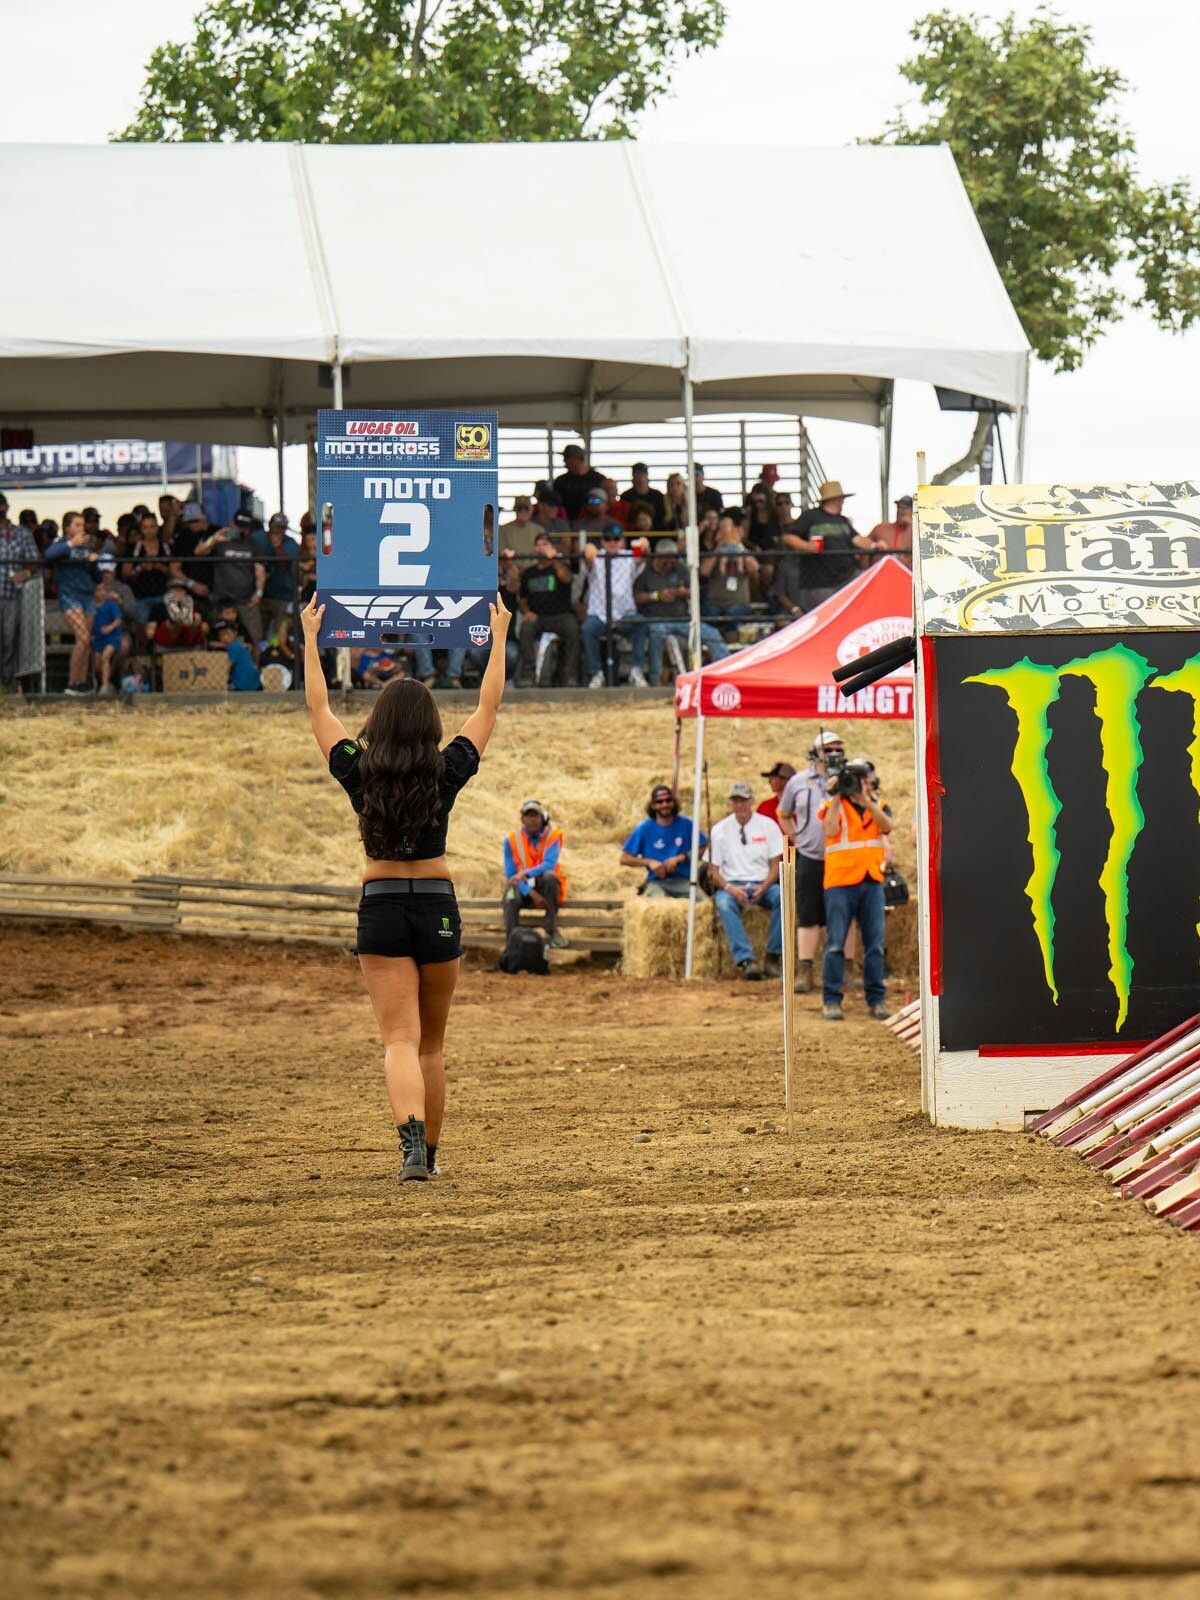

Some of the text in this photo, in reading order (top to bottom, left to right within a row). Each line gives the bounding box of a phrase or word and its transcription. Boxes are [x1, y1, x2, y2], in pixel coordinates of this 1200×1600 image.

[350, 422, 417, 435] LUCAS OIL
[460, 426, 487, 447] 50
[325, 442, 441, 456] MOTOCROSS
[364, 477, 451, 499] MOTO
[379, 502, 431, 586] 2
[817, 685, 914, 713] HANGT
